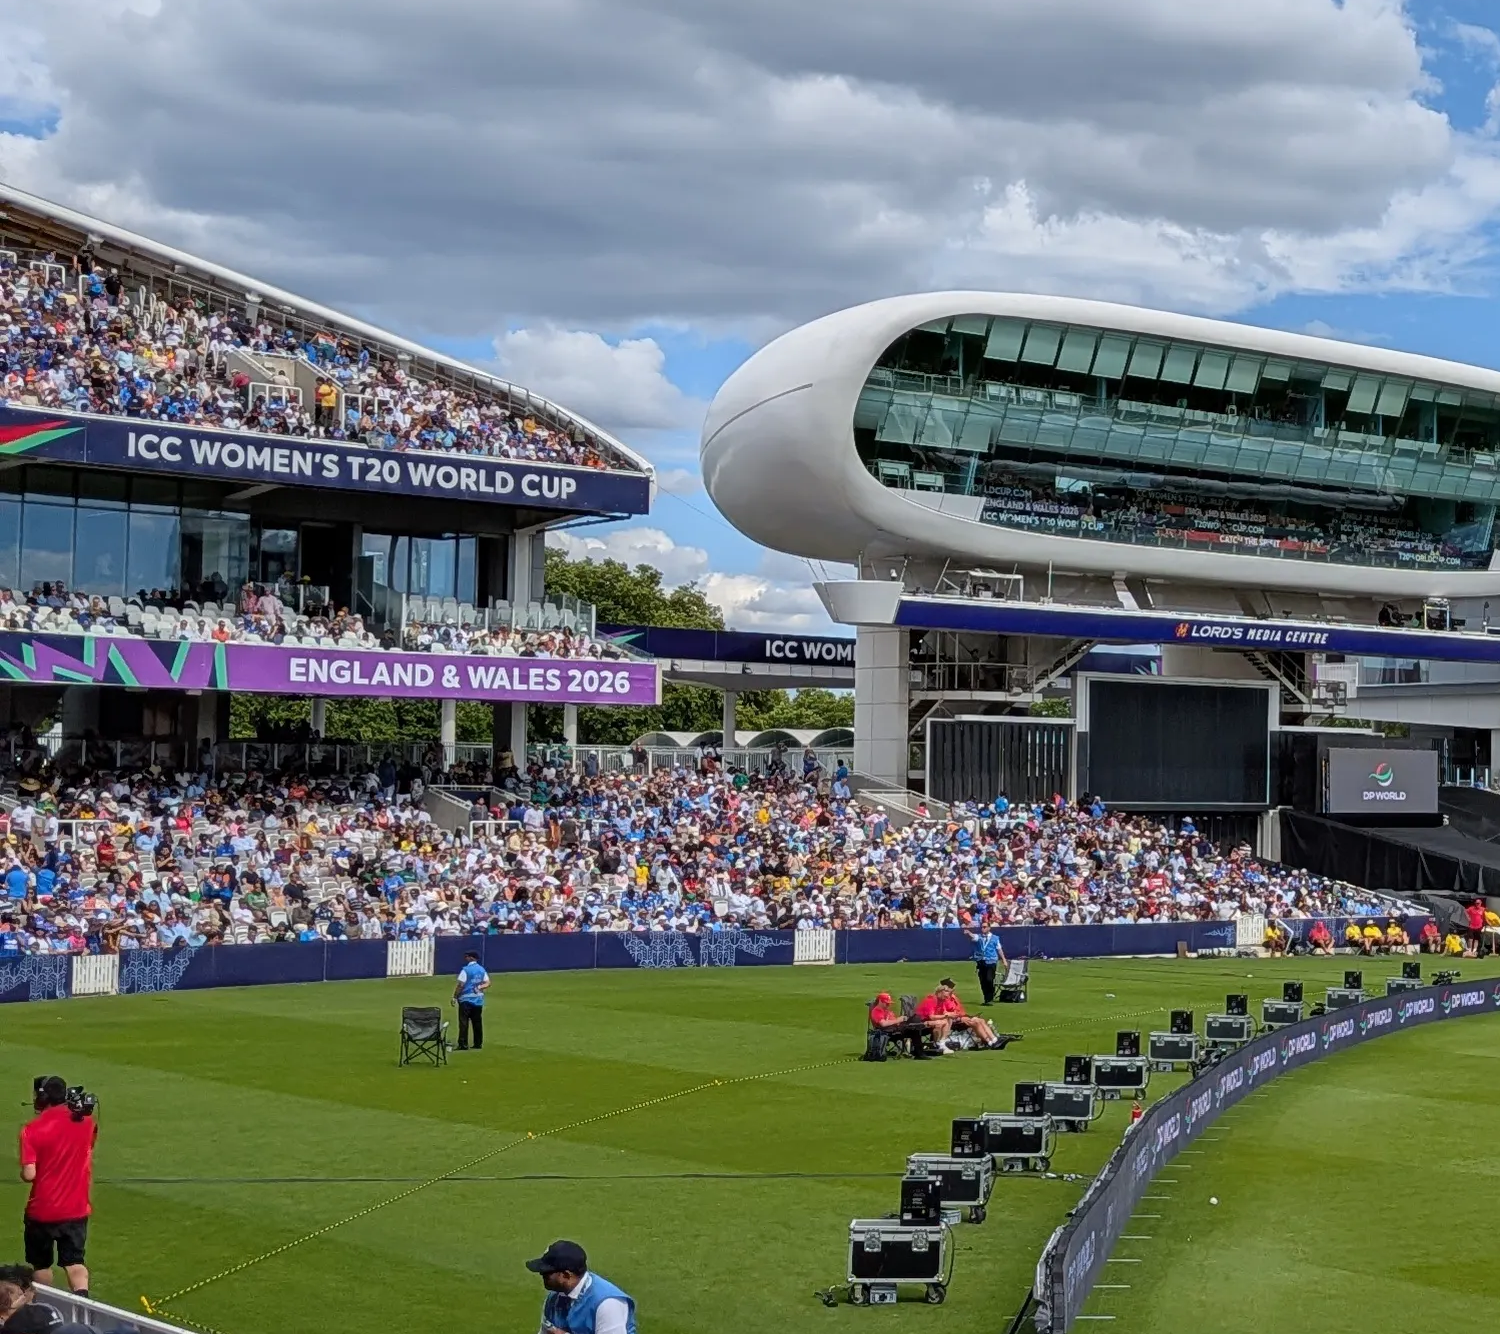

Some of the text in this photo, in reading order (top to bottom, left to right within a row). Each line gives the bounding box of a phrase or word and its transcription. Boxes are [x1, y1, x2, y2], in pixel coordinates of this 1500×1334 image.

[128, 432, 577, 500] ICC WOMEN'S T20 WORLD CUP
[983, 511, 997, 521] ICC
[1088, 522, 1104, 531] CUP
[1190, 624, 1328, 646] LORD'S MEDIA CENTRE
[765, 640, 798, 658] ICC
[289, 657, 631, 693] ENGLAND & WALES 2026
[1363, 791, 1406, 800] DP WORLD
[1406, 998, 1434, 1018] DP WORLD
[1452, 991, 1485, 1008] DP WORLD
